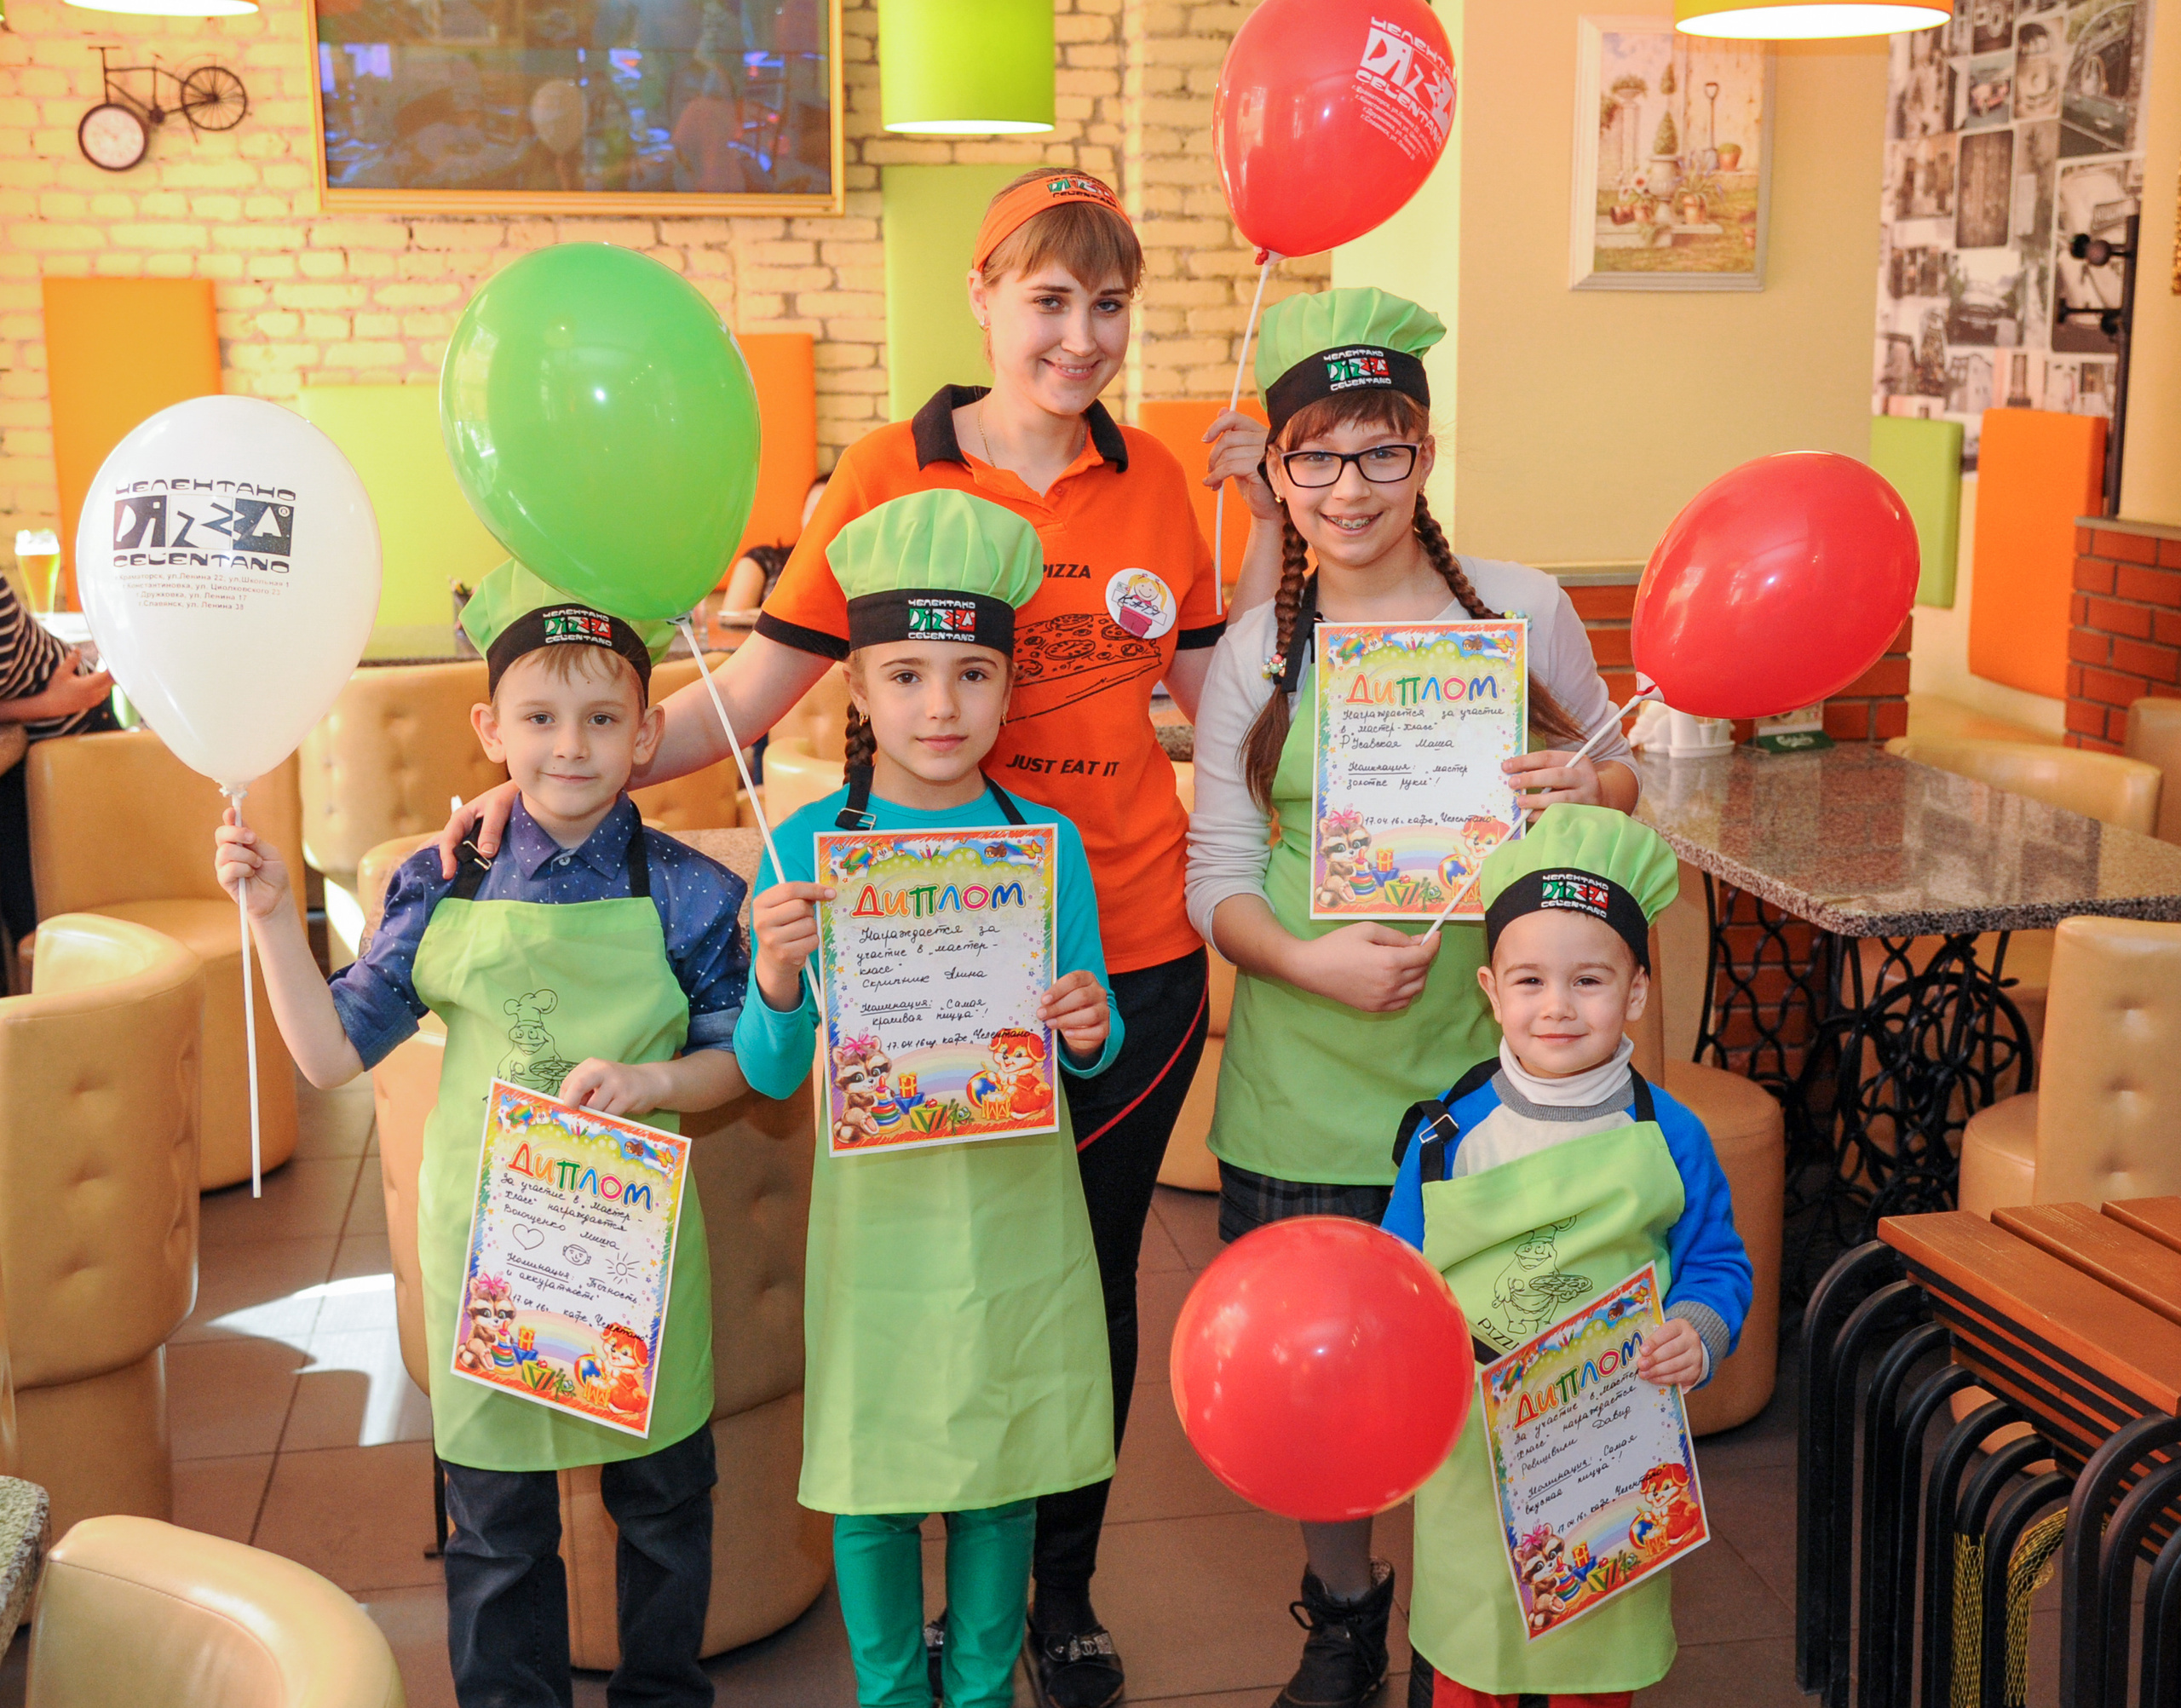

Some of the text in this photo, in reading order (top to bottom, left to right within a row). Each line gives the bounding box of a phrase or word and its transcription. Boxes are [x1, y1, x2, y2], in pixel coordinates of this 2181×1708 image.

[1371, 16, 1456, 89] ЧЕЛЕНТА
[1355, 69, 1442, 150] CELENTANO
[1330, 377, 1391, 391] CELENTANO
[116, 479, 296, 501] ЧЕЛЕНТАНО
[113, 552, 290, 573] CELENTANO
[545, 634, 612, 647] CELENTANO
[908, 632, 975, 641] CELENTANO
[1442, 710, 1454, 719] за
[1460, 707, 1505, 721] участие
[1415, 739, 1454, 751] Маша
[1005, 754, 1120, 777] JUST EAT IT
[1541, 900, 1607, 918] CELENTANO
[979, 925, 1000, 934] за
[856, 947, 907, 967] участие
[917, 944, 924, 953] в
[944, 966, 987, 981] Алина
[521, 1182, 566, 1200] участие
[1478, 1318, 1520, 1350] PIZZ
[1534, 1403, 1579, 1439] участие
[1591, 1406, 1631, 1429] Давид
